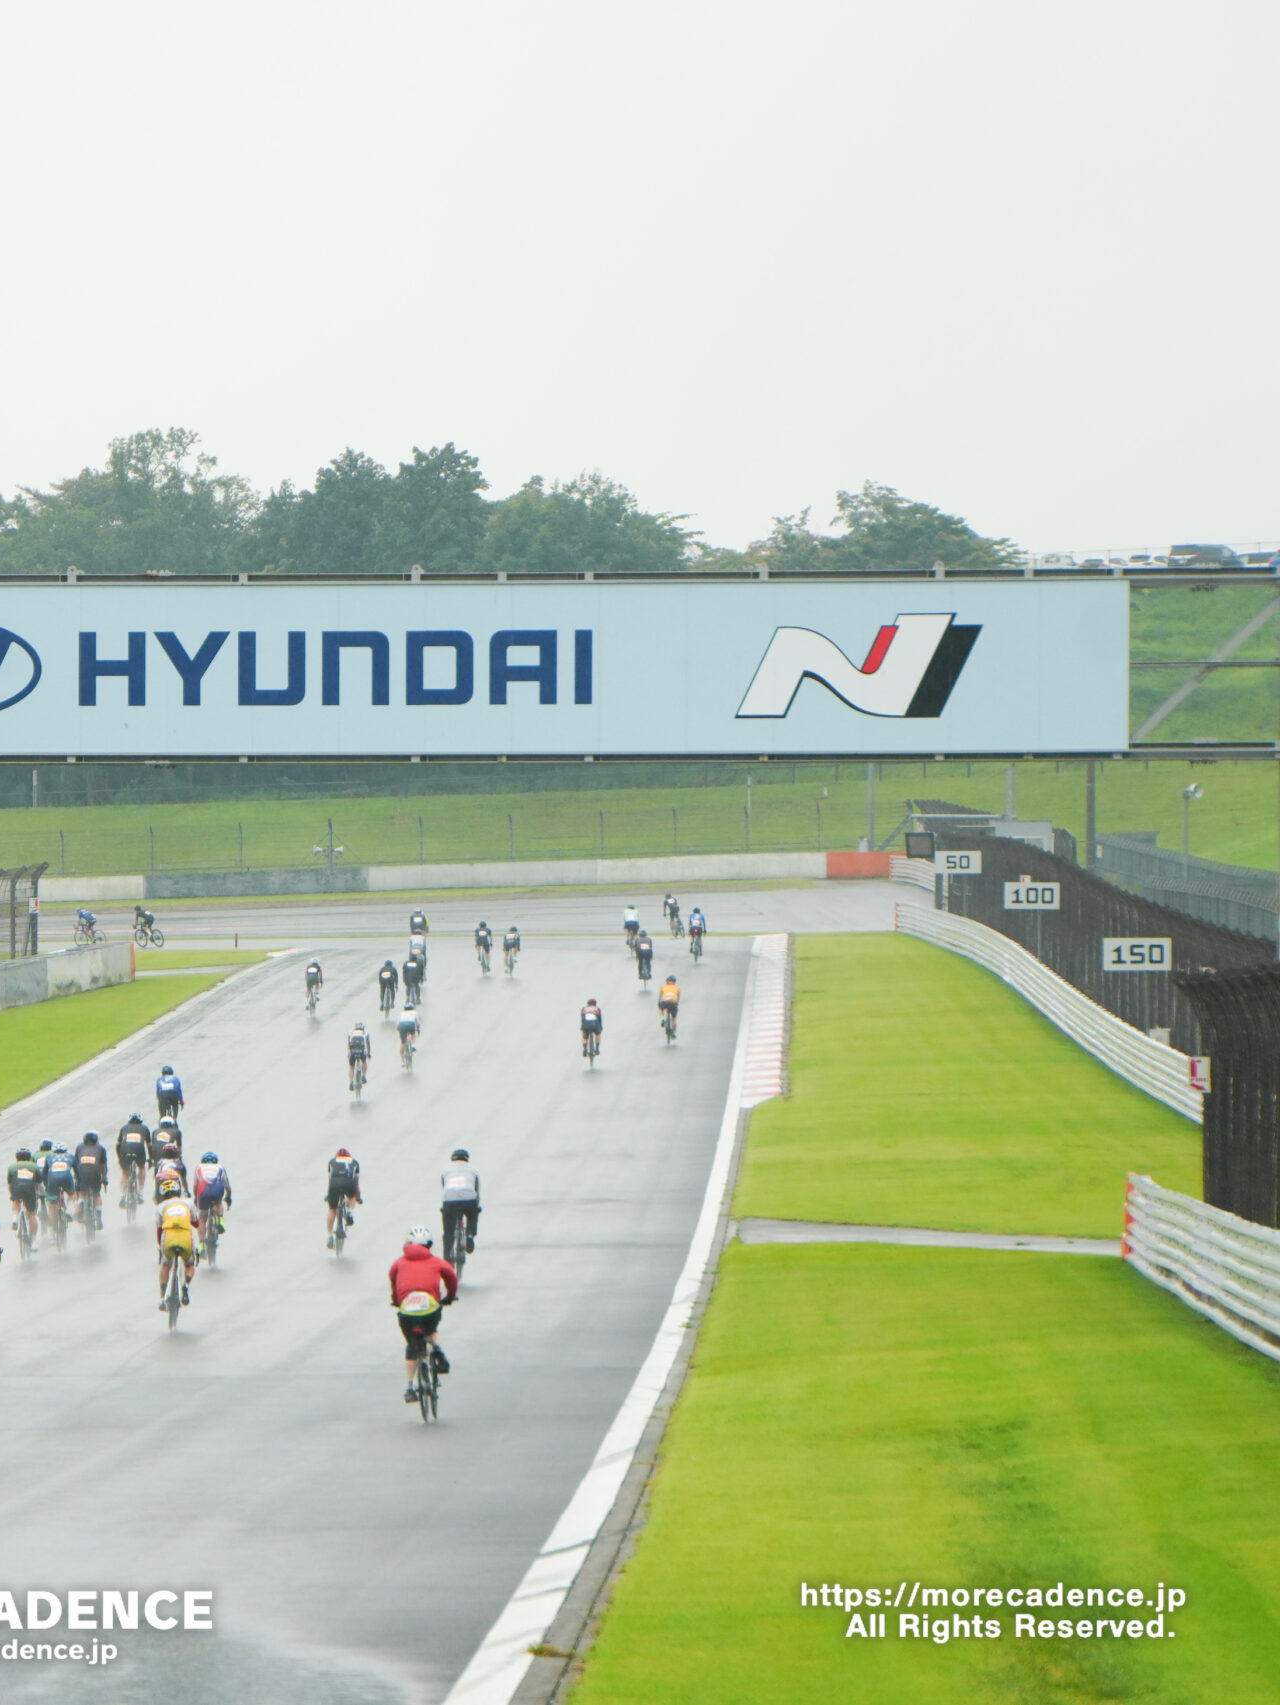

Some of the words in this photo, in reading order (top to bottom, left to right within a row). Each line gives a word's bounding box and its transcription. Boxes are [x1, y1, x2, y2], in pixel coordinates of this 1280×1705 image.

[79, 630, 592, 706] HYUNDAI
[946, 855, 970, 869] 50
[1011, 887, 1054, 904] 100
[1112, 944, 1164, 964] 150
